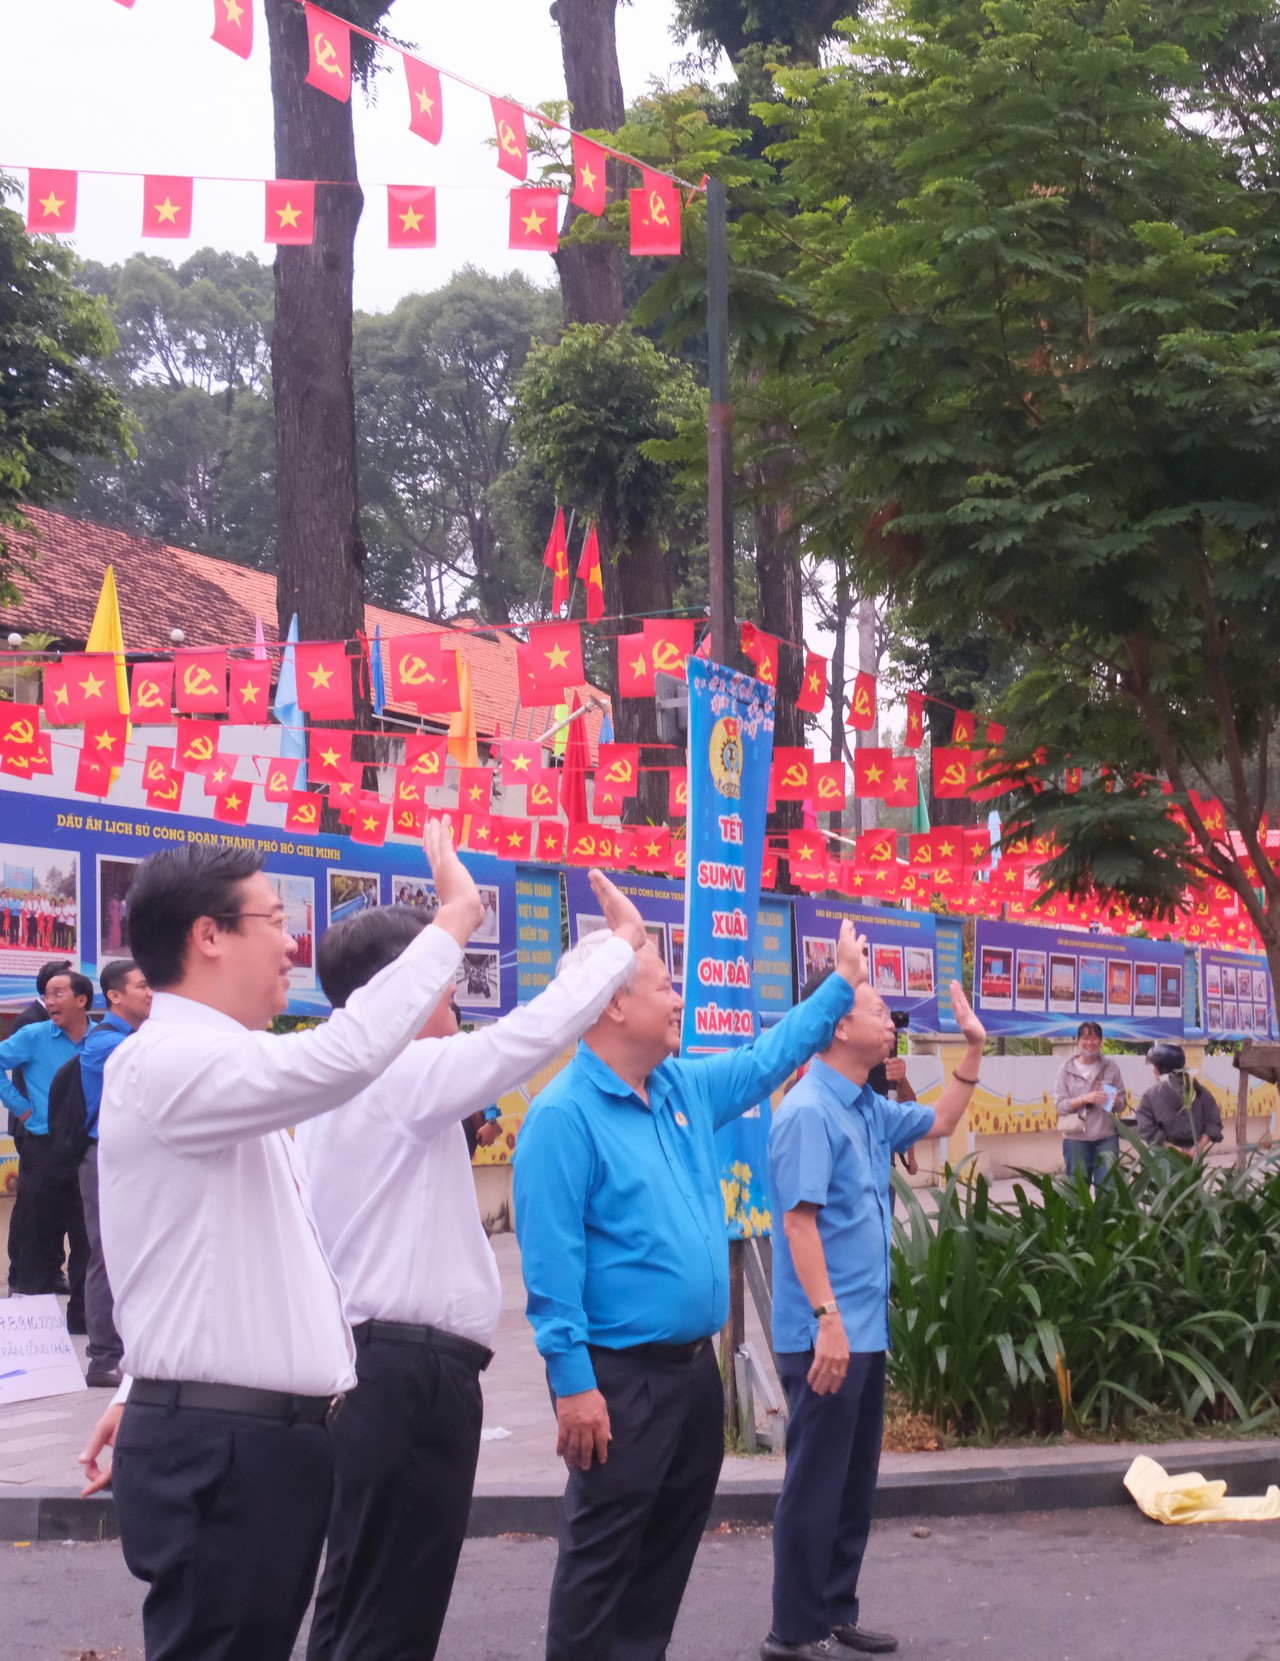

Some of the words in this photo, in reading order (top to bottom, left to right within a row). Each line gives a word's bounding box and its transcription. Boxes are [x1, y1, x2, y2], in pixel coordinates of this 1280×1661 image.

[57, 812, 83, 829] DẤU
[85, 814, 103, 831] ẤN
[105, 819, 133, 836] LỊCH
[135, 822, 151, 837] SỬ
[153, 825, 185, 842] CÔNG
[187, 831, 218, 845] ĐOÀN
[220, 834, 255, 849] THÀNH
[257, 838, 278, 852] PHỐ
[280, 840, 295, 854] HỒ
[315, 846, 341, 861] MINH
[718, 813, 743, 846] TẾT
[698, 861, 732, 891] SUM
[533, 905, 549, 920] NAM
[698, 957, 724, 987] ƠN
[695, 1002, 733, 1035] NĂM
[733, 1009, 754, 1036] 20
